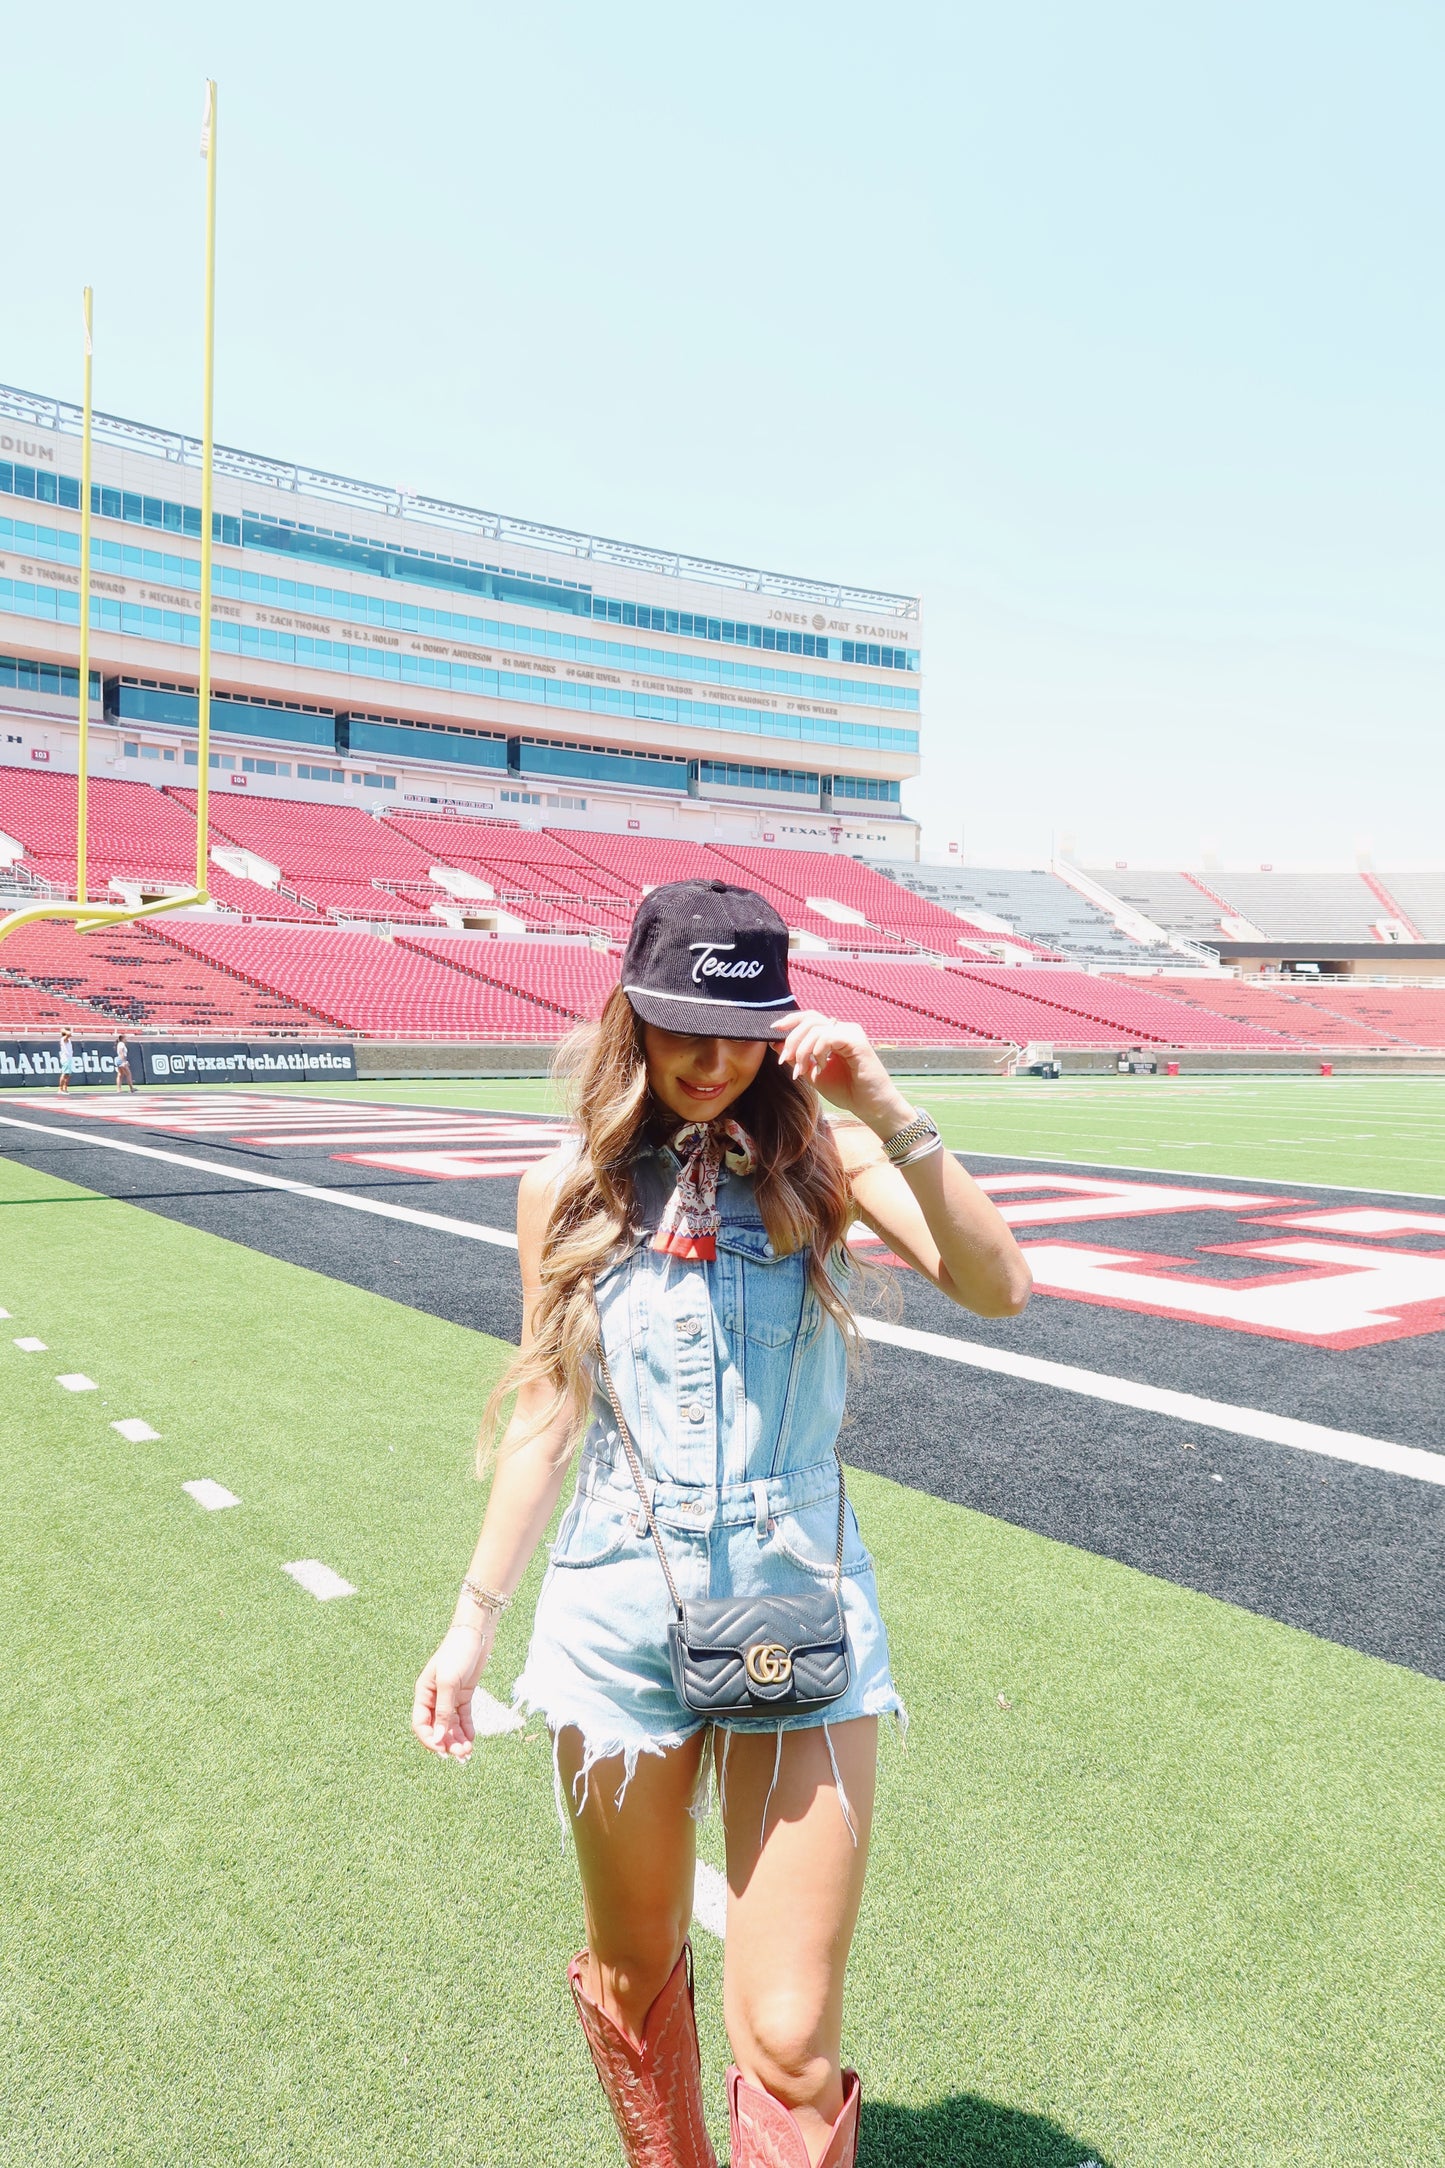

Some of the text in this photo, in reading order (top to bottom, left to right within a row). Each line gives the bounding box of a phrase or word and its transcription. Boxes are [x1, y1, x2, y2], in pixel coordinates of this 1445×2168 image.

[1, 434, 54, 461] DIUM
[36, 567, 79, 585] THOMAS
[89, 580, 126, 594] OWARD
[149, 591, 192, 607] MICHAEL
[194, 600, 241, 617] CBTREE
[270, 615, 293, 627] ZACH
[295, 620, 331, 634] THOMAS
[767, 609, 909, 640] JONES AT&T STADIUM
[452, 649, 492, 663] ANDERSON
[533, 662, 556, 673] PARKS
[780, 826, 827, 836] TEXAS
[845, 832, 886, 841] TECH
[689, 943, 764, 983] Texas
[171, 1053, 351, 1074] @TexasTechAthletics
